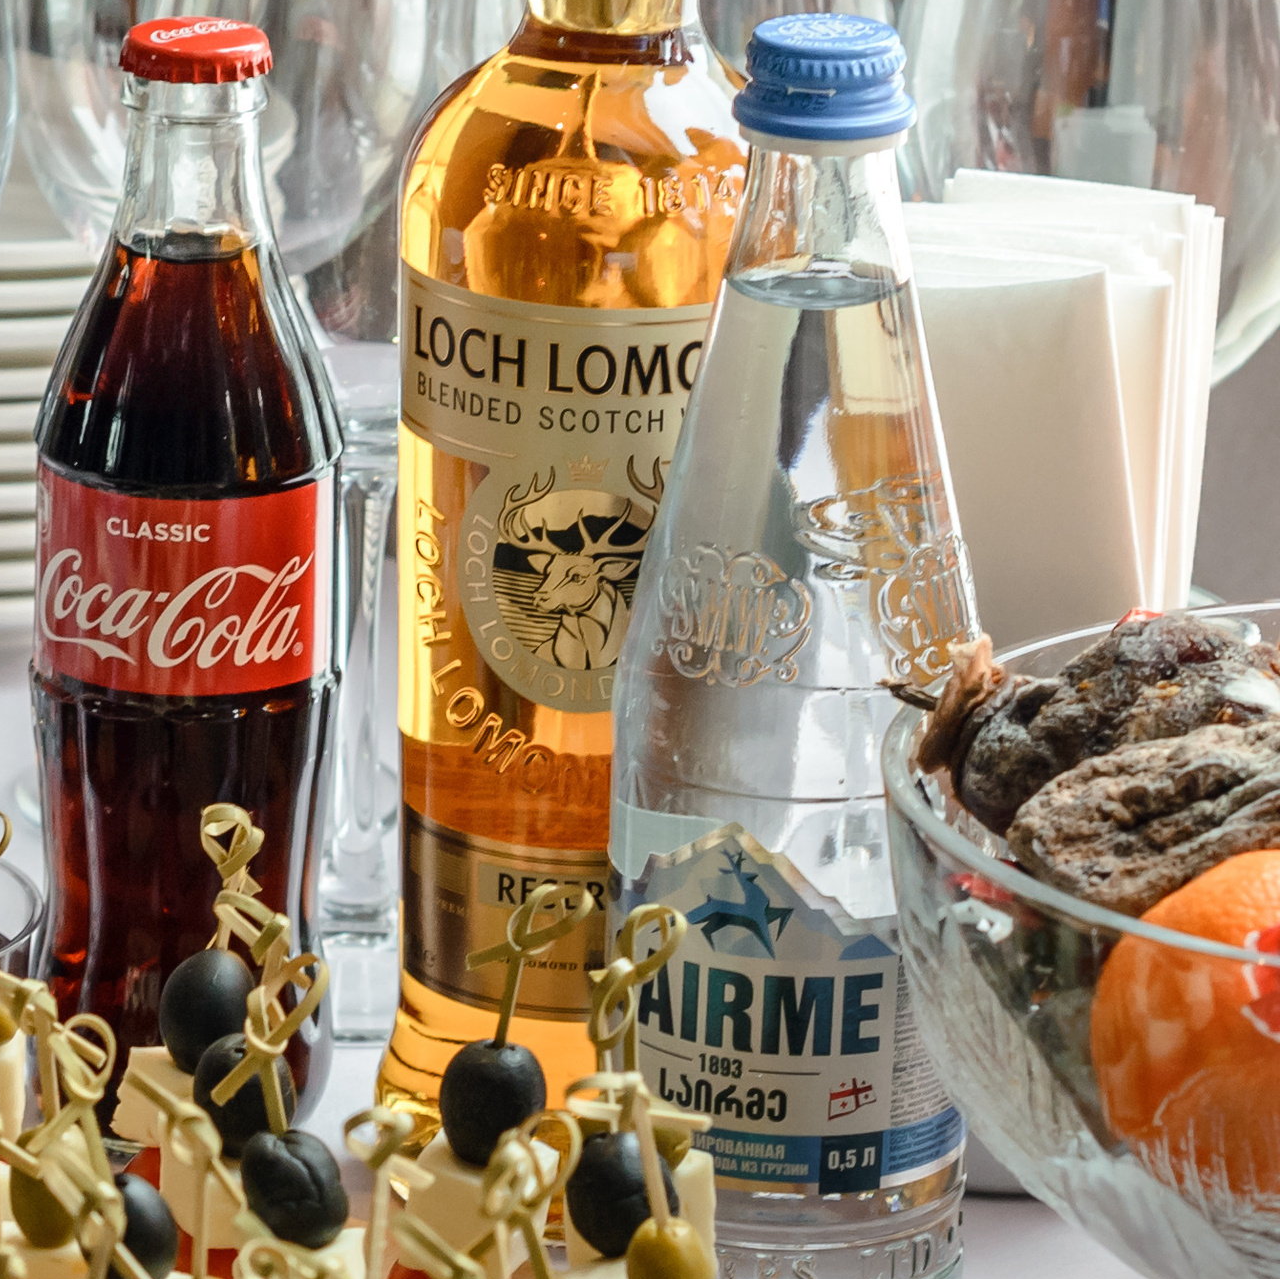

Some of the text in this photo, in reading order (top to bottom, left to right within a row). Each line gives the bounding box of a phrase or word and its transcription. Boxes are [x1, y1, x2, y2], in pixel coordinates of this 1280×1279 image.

[150, 19, 252, 44] Coca-Cola
[483, 162, 738, 219] SINCE 1814
[413, 304, 527, 390] LOCH
[416, 369, 665, 435] BLENDED SCOTCH
[105, 516, 211, 543] CLASSIC
[413, 496, 453, 648] LOCH
[464, 513, 497, 604] LOCH
[40, 547, 315, 670] Coca-Cola
[616, 930, 885, 1058] AIRME
[698, 1052, 744, 1079] 1893
[658, 1067, 788, 1123] საირმე
[741, 1160, 758, 1174] ИЗ
[760, 1162, 809, 1177] ГРУЗИИ
[827, 1146, 877, 1172] 0,5 Л
